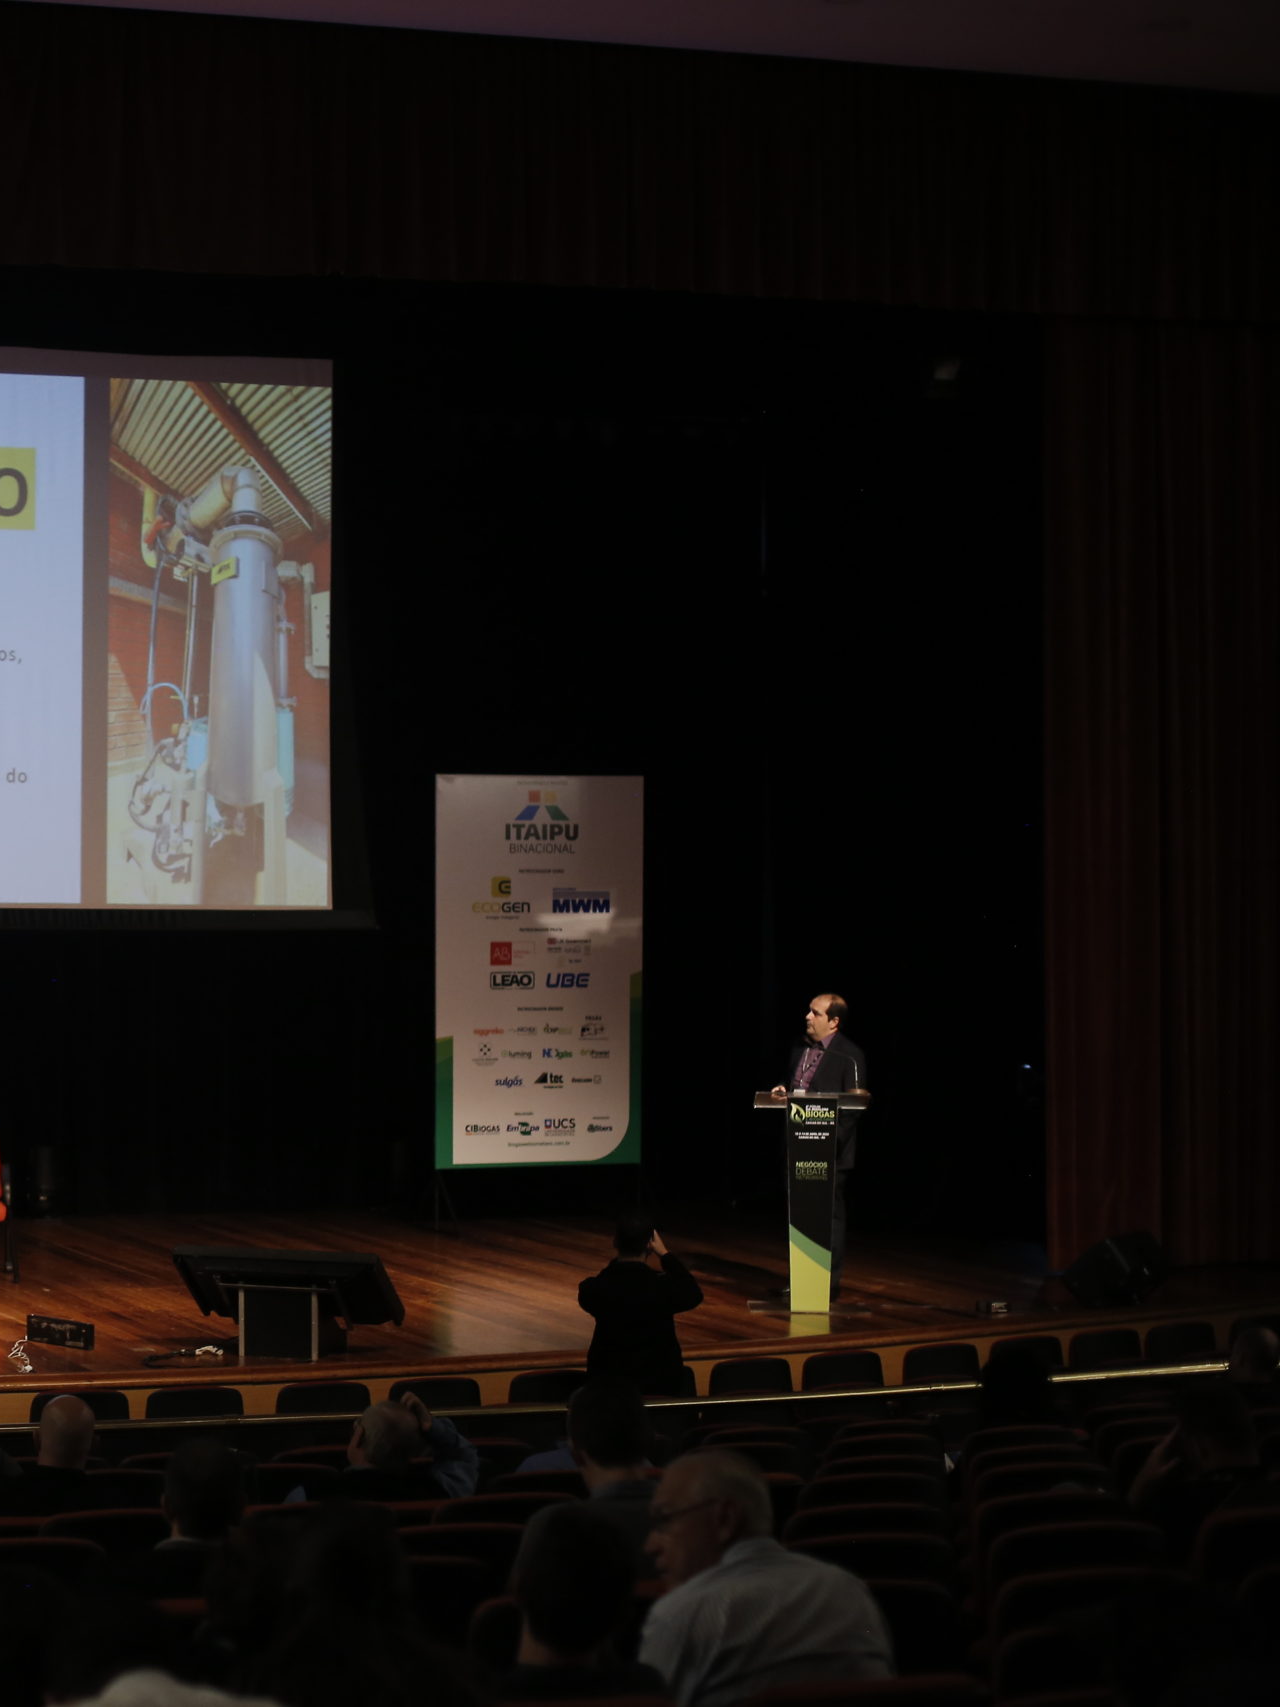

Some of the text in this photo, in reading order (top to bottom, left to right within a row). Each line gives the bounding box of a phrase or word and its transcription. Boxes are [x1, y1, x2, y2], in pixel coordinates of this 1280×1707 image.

[6, 768, 28, 784] do
[505, 823, 580, 841] ITAIPU
[509, 843, 576, 854] BINACIONAL
[552, 898, 610, 913] MWM
[546, 973, 591, 988] UBE
[553, 1118, 576, 1129] UCS
